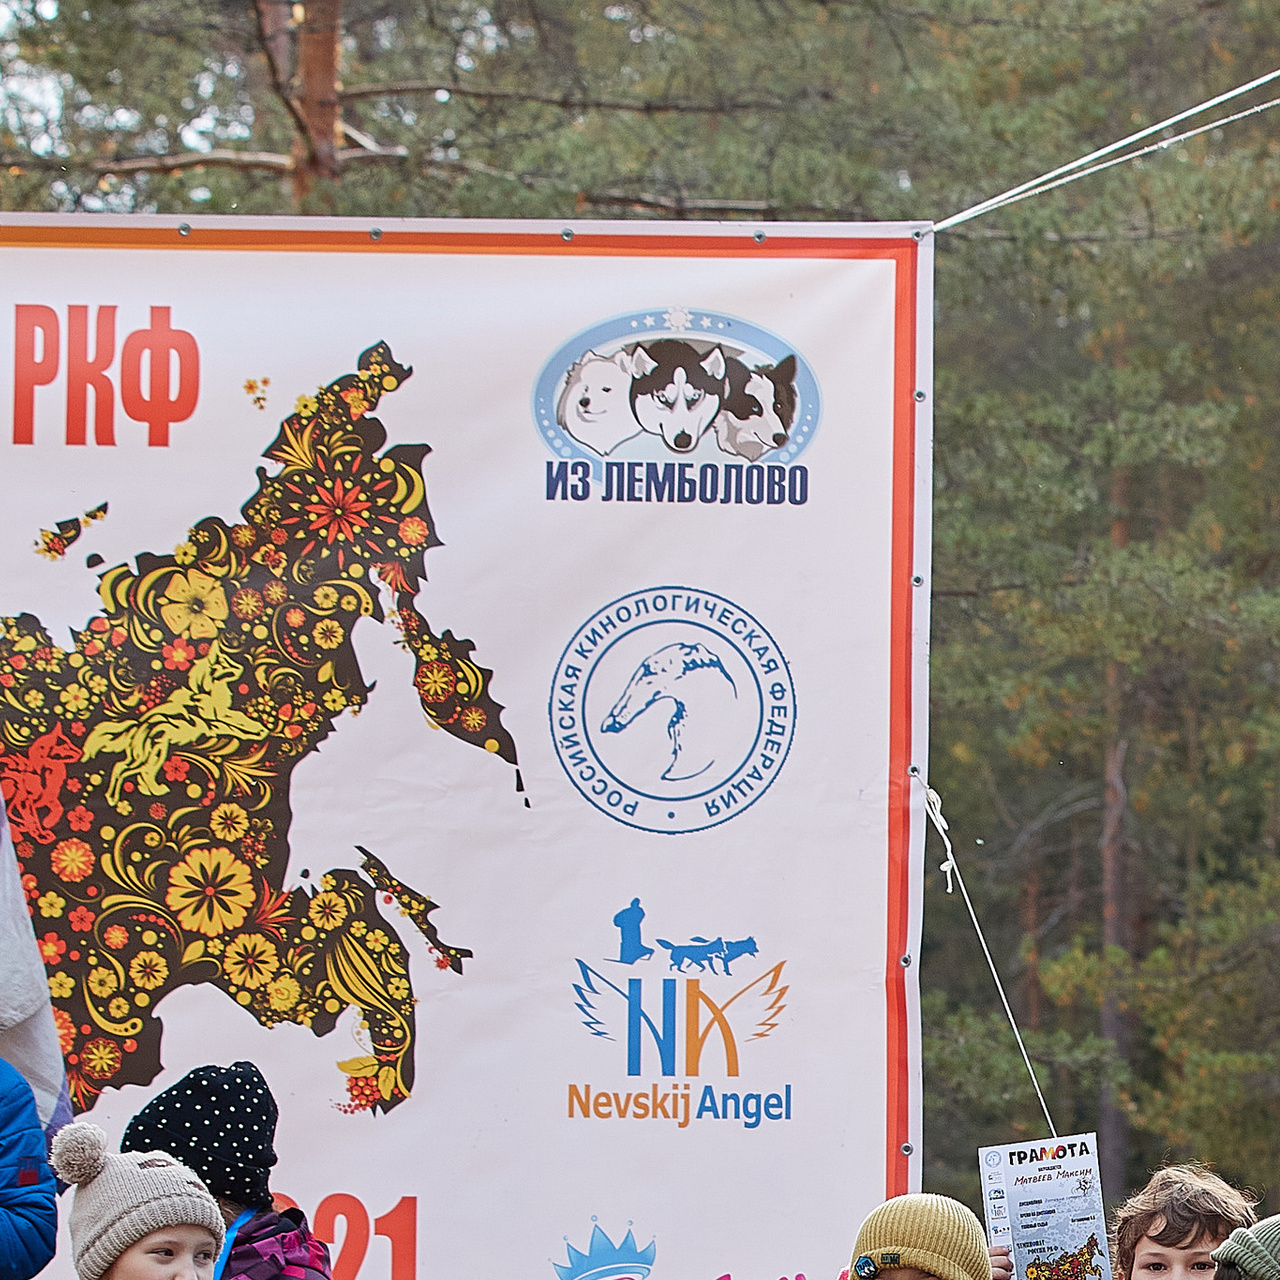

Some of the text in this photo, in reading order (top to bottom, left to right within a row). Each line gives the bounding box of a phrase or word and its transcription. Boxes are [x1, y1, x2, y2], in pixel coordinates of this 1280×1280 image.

[13, 304, 200, 447] РКФ
[546, 461, 808, 505] ИЗ ЛЕМБОЛОВО
[558, 595, 788, 818] РОССИЙСКАЯ КИНОЛОГИЧЕСКАЯ ФЕДЕРАЦИЯ
[568, 1084, 792, 1129] Nevskij Angel
[1008, 1141, 1090, 1165] ГРАМОТА
[1056, 1168, 1093, 1180] Максим
